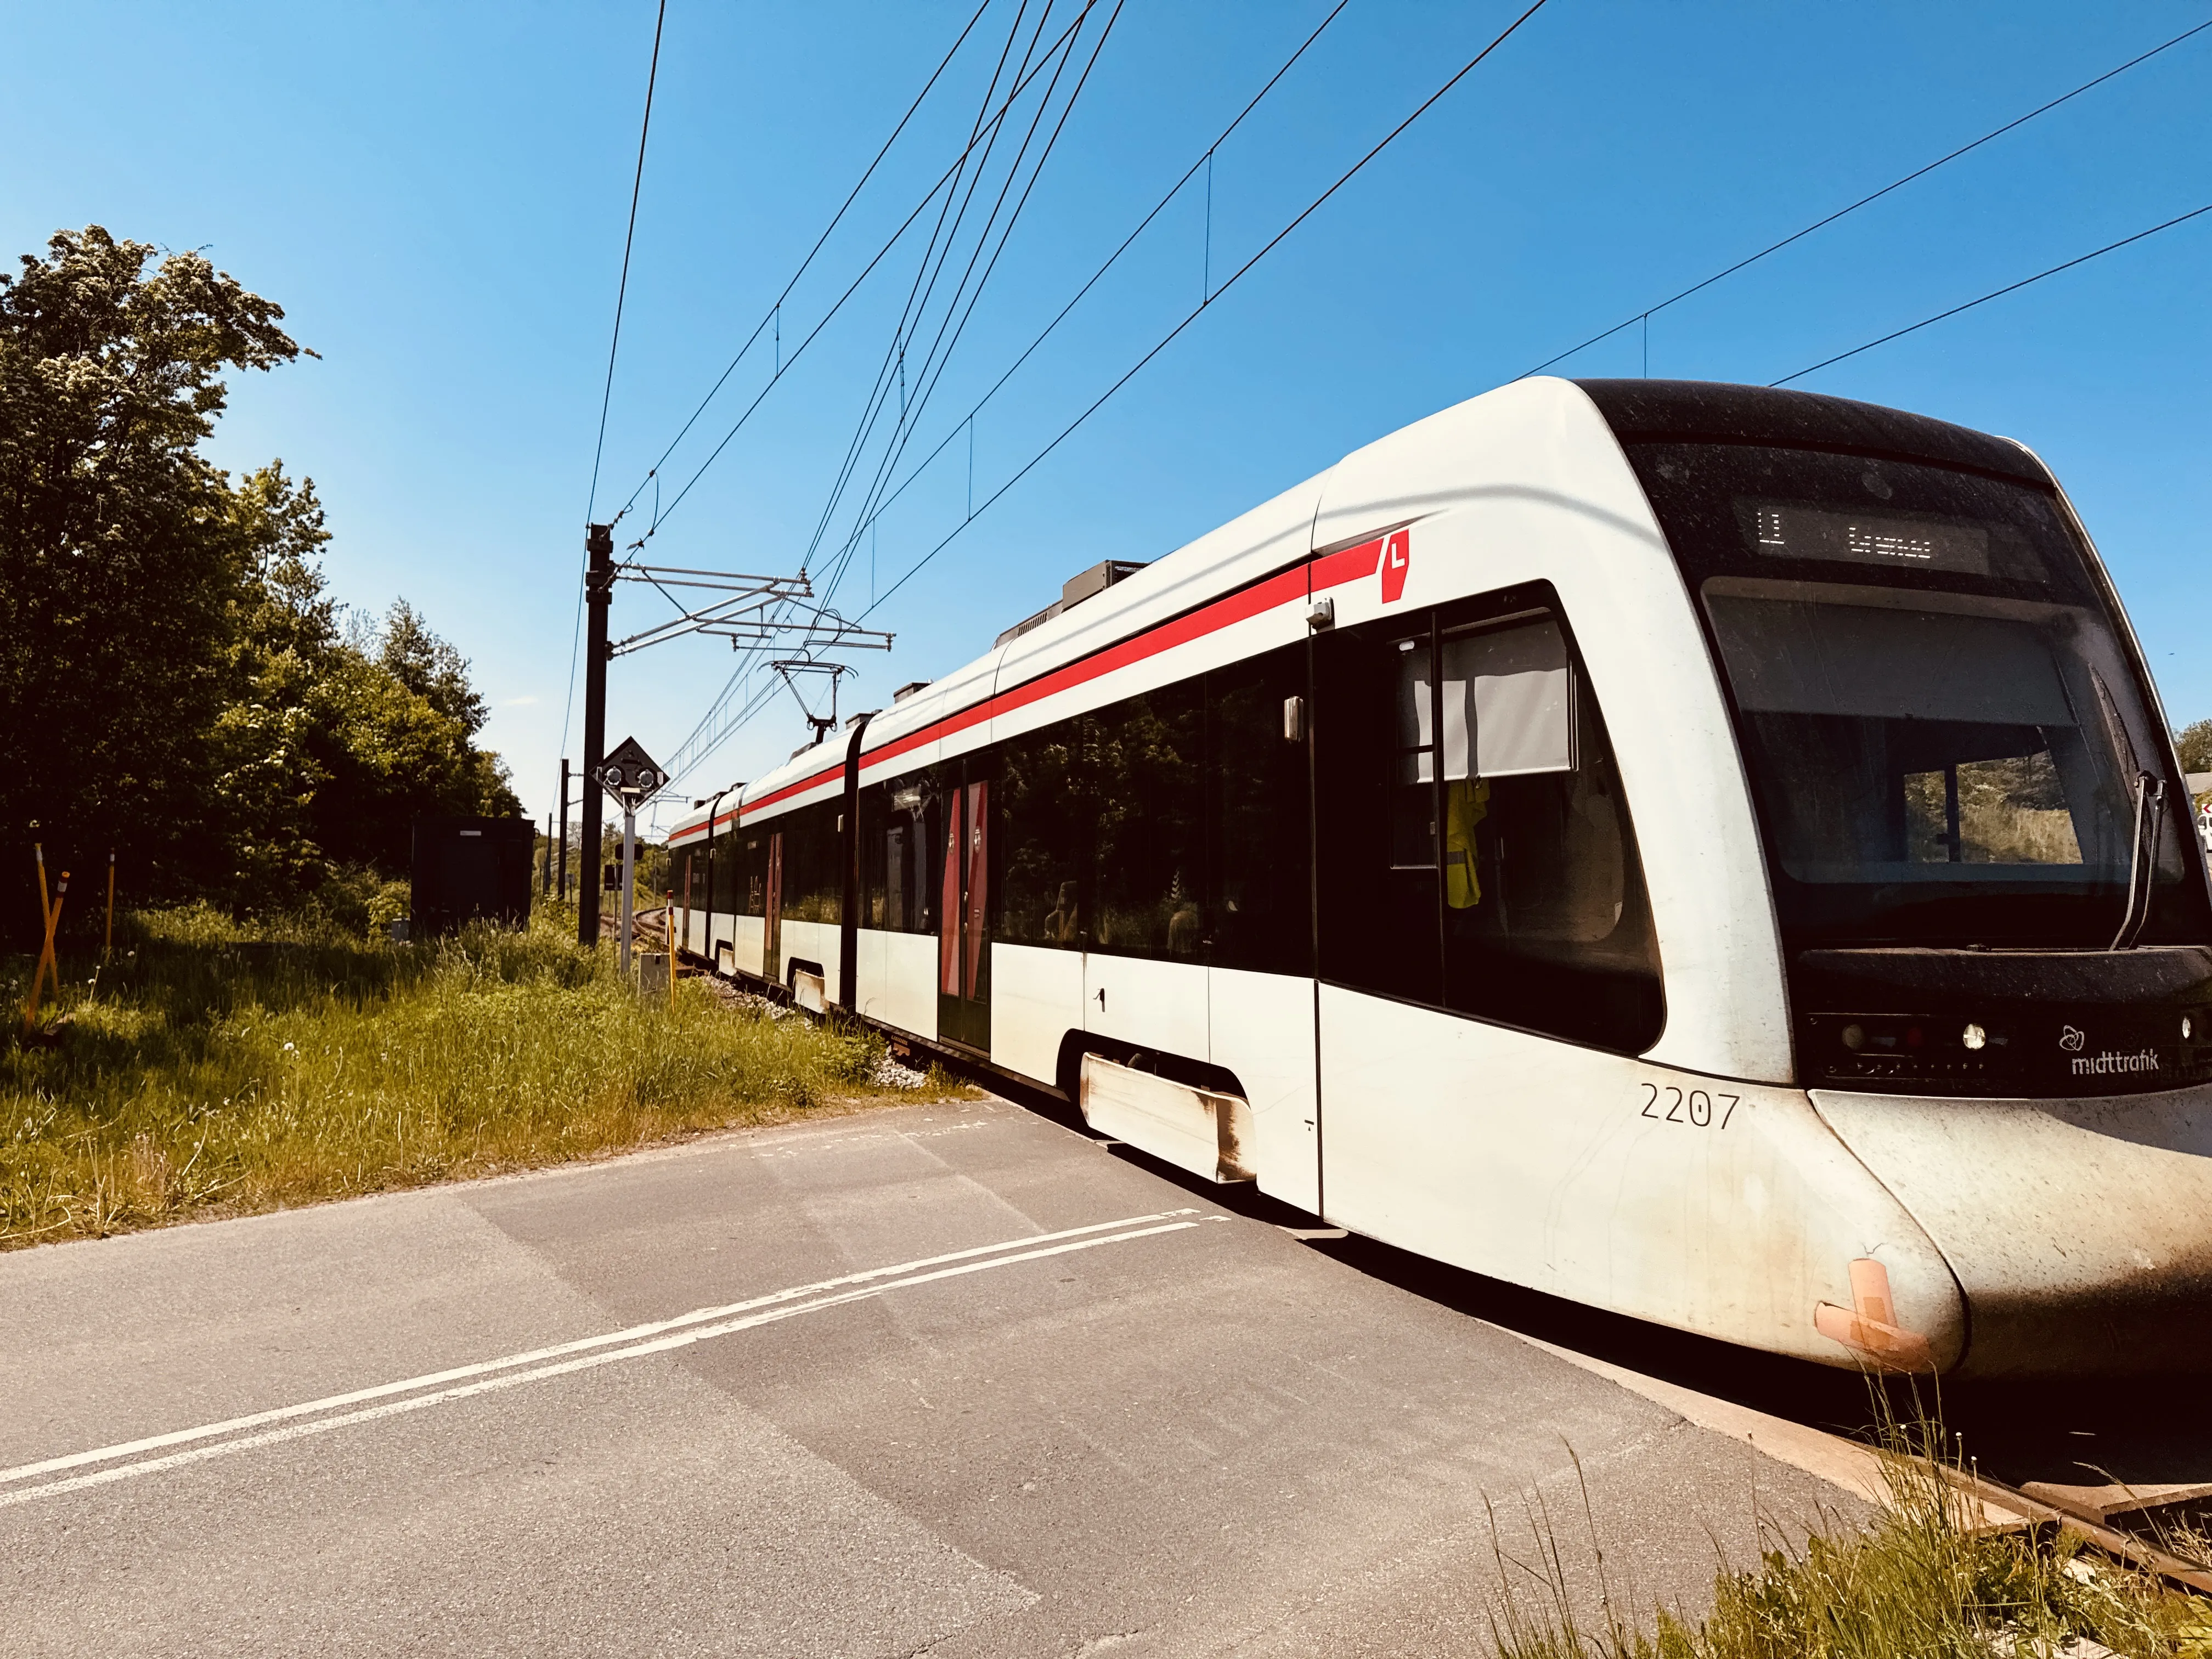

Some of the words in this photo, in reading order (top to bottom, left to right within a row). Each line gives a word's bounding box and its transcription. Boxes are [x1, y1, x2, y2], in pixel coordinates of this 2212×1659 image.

[1391, 541, 1406, 569] L
[2072, 1048, 2159, 1075] midttrafik
[1641, 1083, 1740, 1130] 2207
